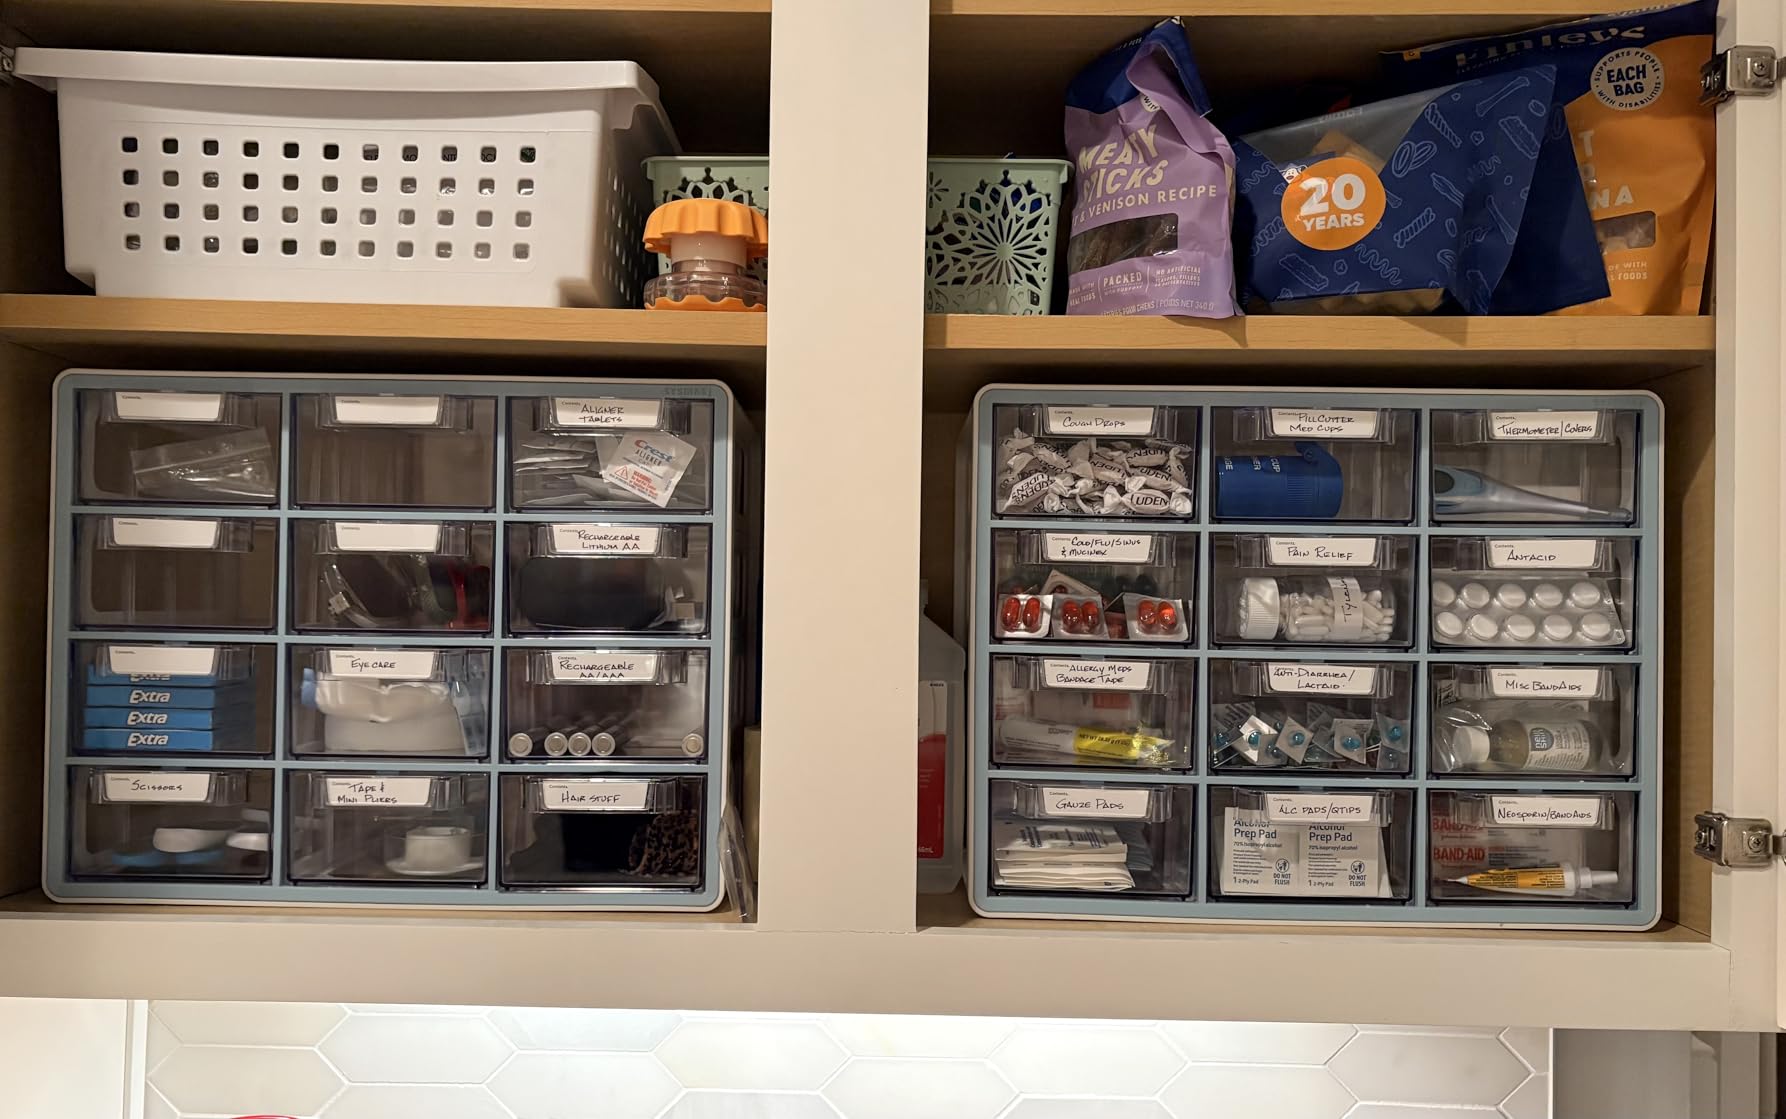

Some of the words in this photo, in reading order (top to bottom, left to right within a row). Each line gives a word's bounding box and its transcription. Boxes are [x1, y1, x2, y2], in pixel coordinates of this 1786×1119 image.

[1594, 51, 1631, 81] SUPPORTS
[1635, 51, 1660, 73] PEOPLE
[1607, 64, 1647, 83] EACH
[1598, 90, 1616, 105] WITH
[1618, 82, 1661, 108] DISABILITIES
[1613, 81, 1644, 97] BAG
[1078, 124, 1159, 173] MEATY
[1299, 173, 1366, 216] 20
[1088, 192, 1149, 218] VENISON
[1157, 184, 1217, 203] RECIPE
[1303, 213, 1365, 232] YEARS
[1623, 261, 1647, 269] WITH
[1103, 271, 1142, 287] PACKED
[580, 403, 625, 414] ALIGNER
[578, 416, 623, 424] TABLETS
[1062, 416, 1093, 427] COUGH
[1094, 417, 1126, 428] DROPS
[1289, 424, 1313, 432] MED
[1318, 424, 1344, 432] CUPS
[634, 439, 673, 463] Crest
[1131, 494, 1168, 506] LUDEN
[582, 541, 618, 551] LITHIUM
[622, 542, 640, 550] AA
[1069, 548, 1108, 556] MUCINEX
[1287, 546, 1309, 557] PAIN
[1315, 546, 1353, 560] RELIEF
[1506, 549, 1556, 561] ANTACID
[559, 660, 634, 670] RECHARGEABLE
[1069, 665, 1105, 675] ALLERGY
[1108, 664, 1133, 674] MEDS
[1096, 674, 1125, 684] TAPE
[1505, 679, 1529, 690] MISC
[129, 689, 170, 704] Extra
[127, 711, 168, 725] Extra
[127, 732, 168, 747] Extra
[131, 780, 183, 790] SCISSORS
[348, 782, 376, 793] TAPE
[337, 795, 358, 803] MINI
[364, 795, 397, 803] PLIERS
[561, 790, 586, 803] HAIR
[589, 794, 621, 803] STUFF
[1055, 798, 1091, 809] GAUZE
[1095, 798, 1124, 810] PADS
[1234, 828, 1257, 840] Prep
[1258, 829, 1277, 839] Pad
[1309, 832, 1332, 843] Prep
[1334, 832, 1353, 842] Pad
[1432, 846, 1486, 862] BAND-AID
